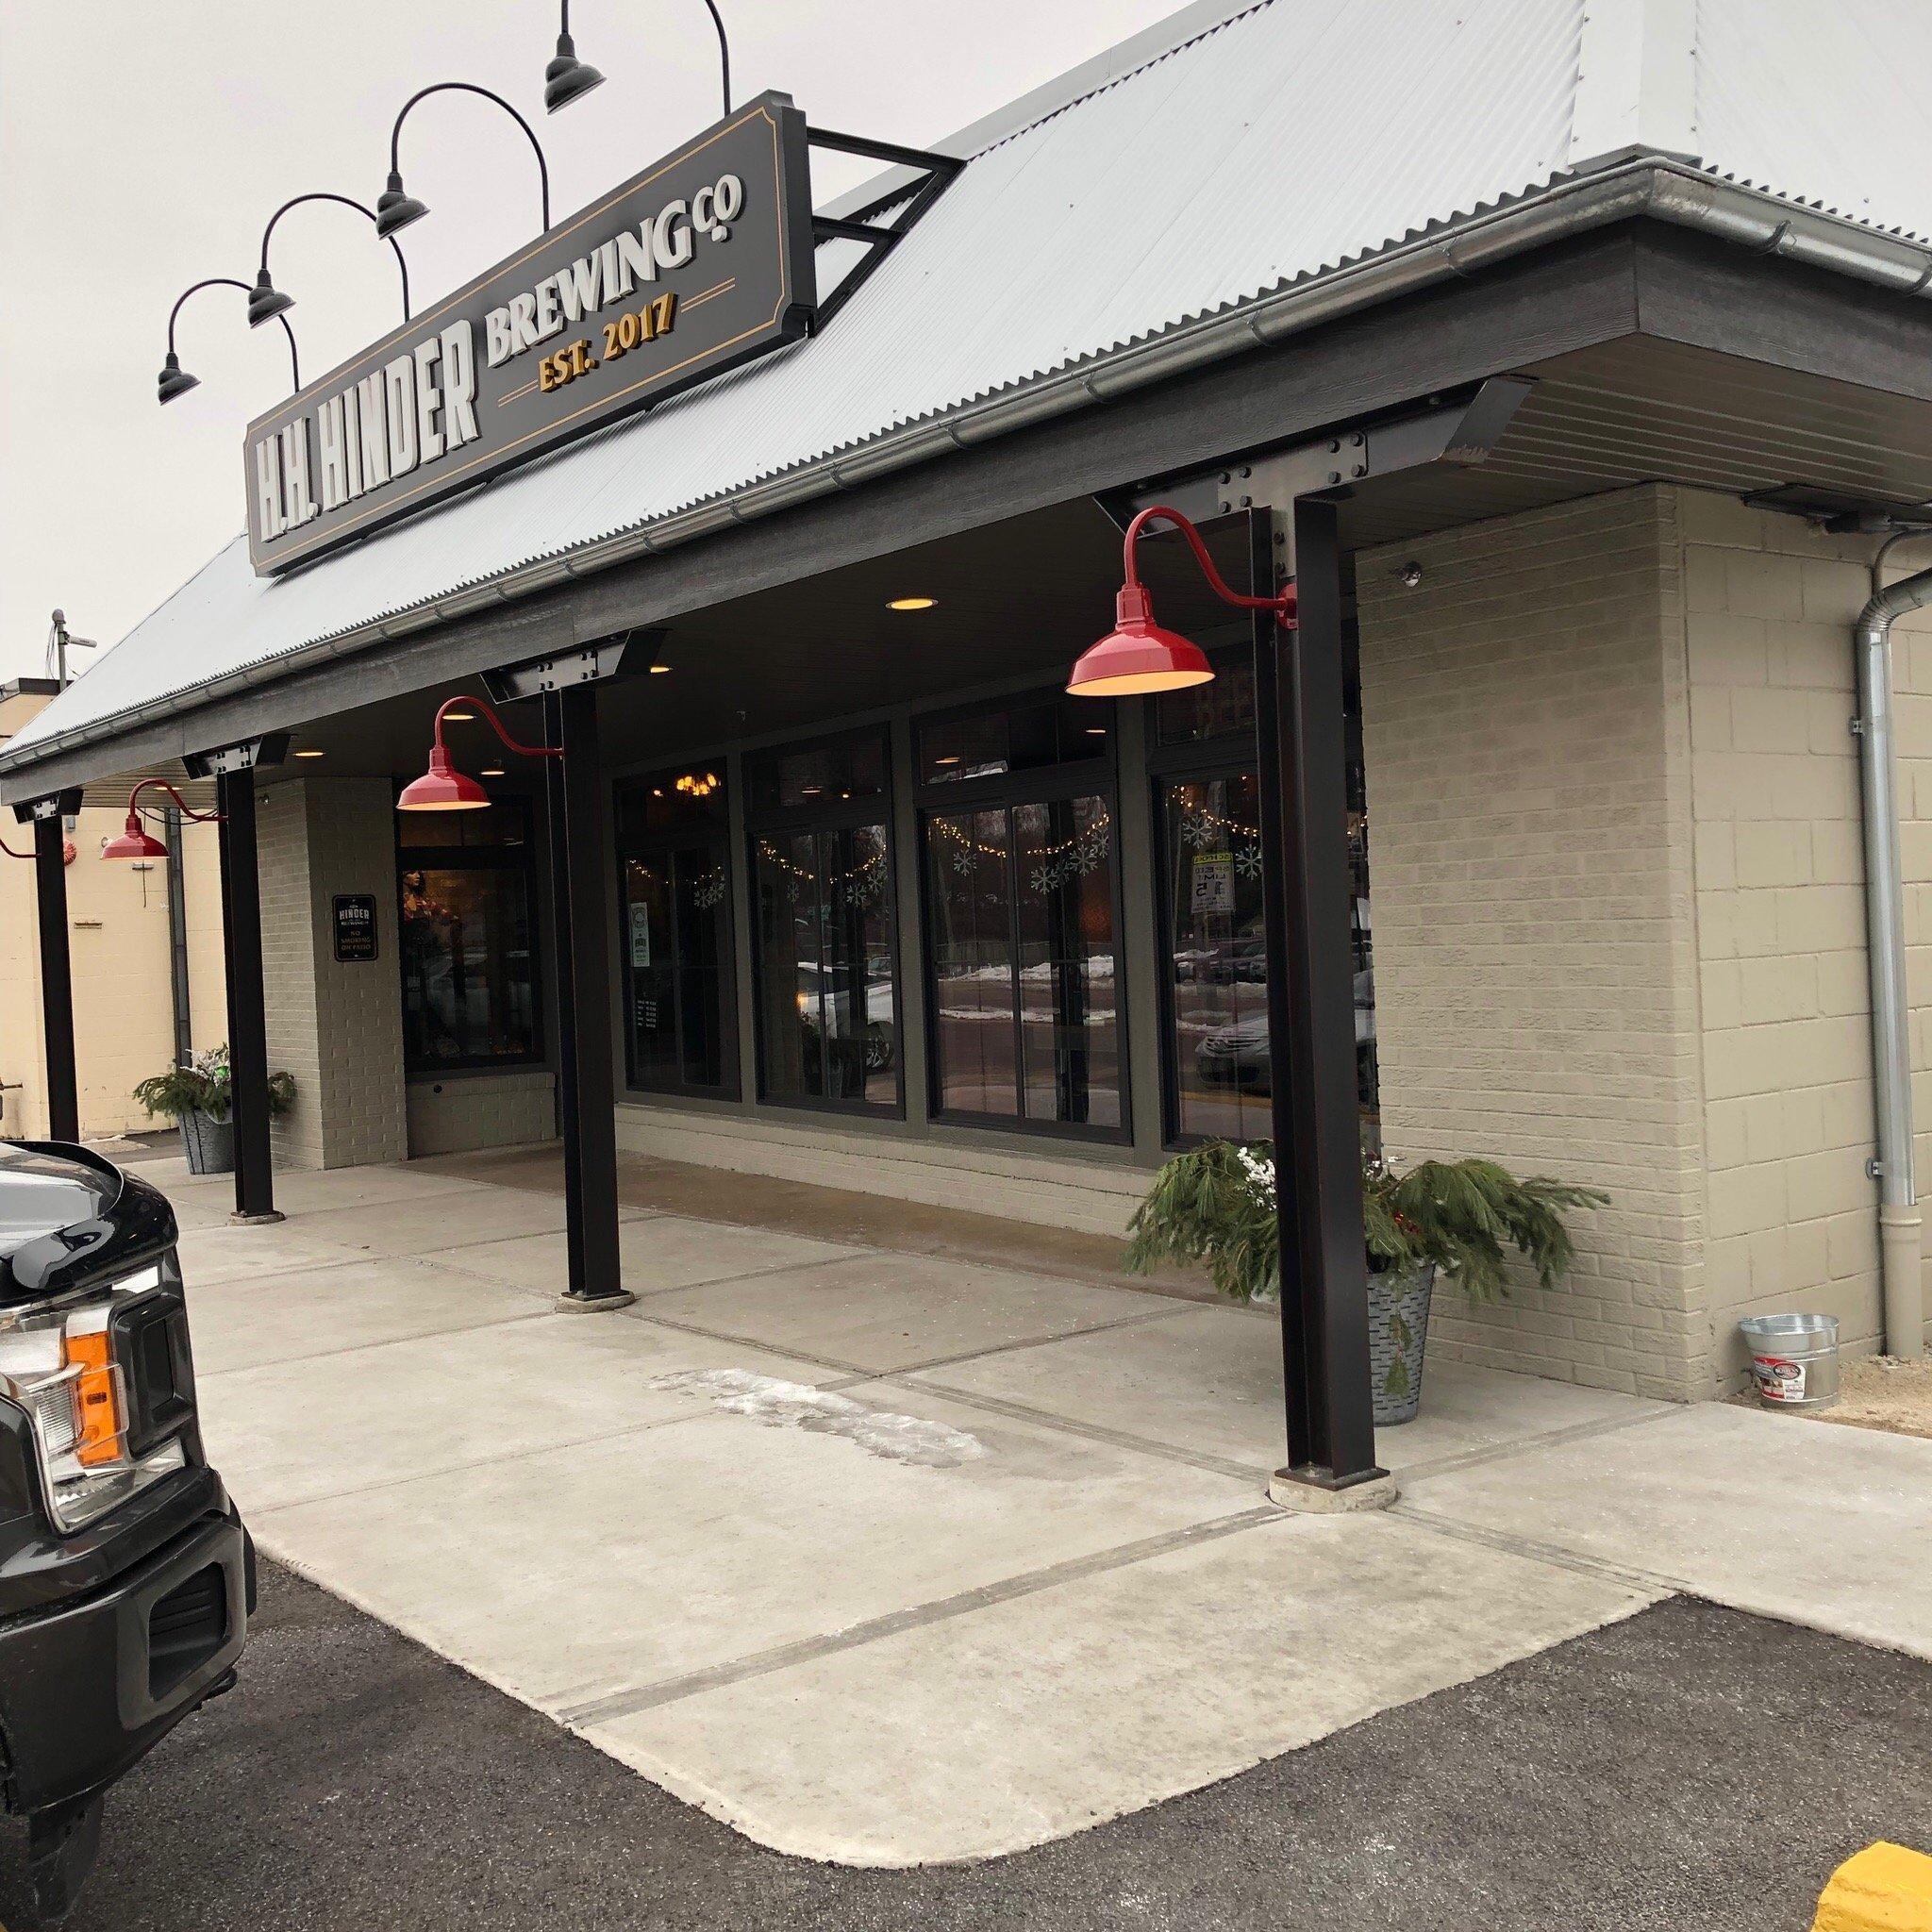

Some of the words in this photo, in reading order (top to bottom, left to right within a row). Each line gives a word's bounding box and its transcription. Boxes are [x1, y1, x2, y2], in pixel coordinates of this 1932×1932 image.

[485, 199, 693, 369] BREWING
[538, 339, 598, 392] EST.
[603, 292, 677, 360] 2017
[256, 416, 319, 543] H.H.
[316, 318, 480, 512] HINDER
[339, 908, 370, 921] HINDER
